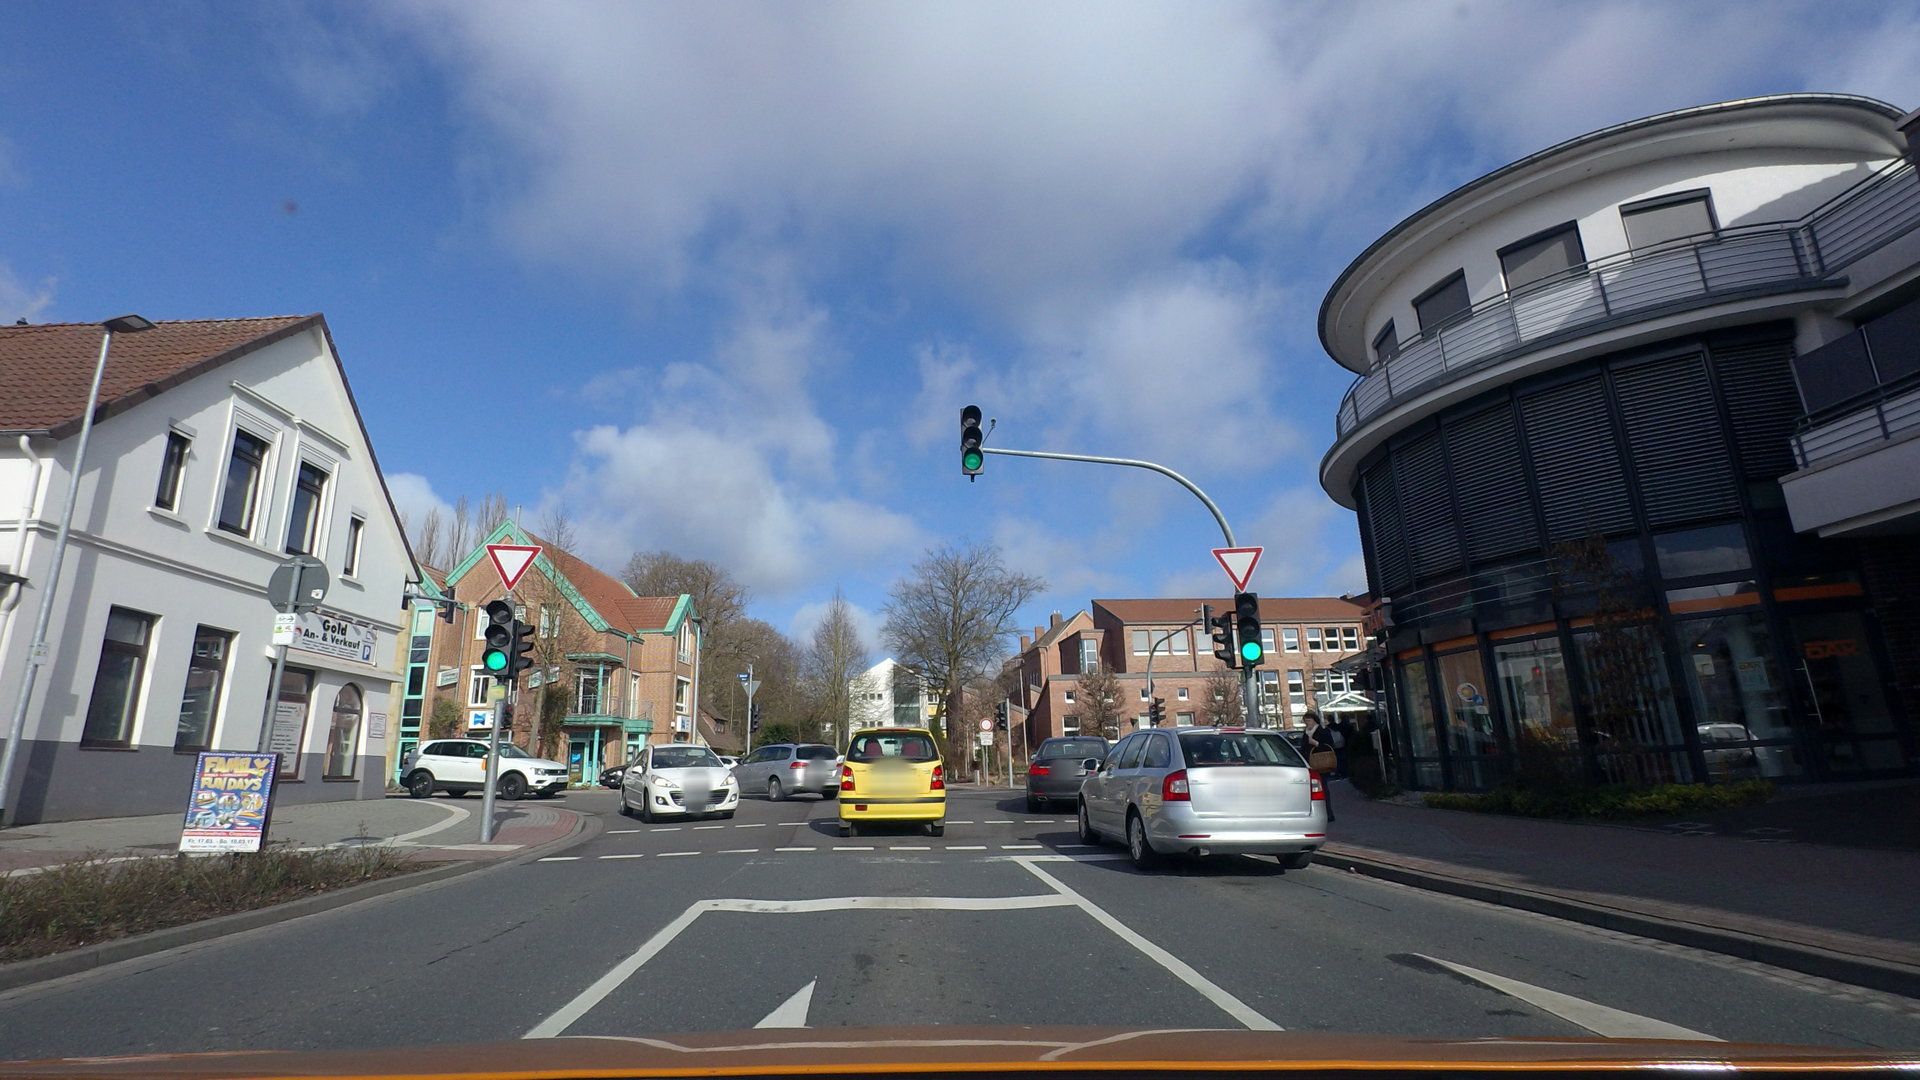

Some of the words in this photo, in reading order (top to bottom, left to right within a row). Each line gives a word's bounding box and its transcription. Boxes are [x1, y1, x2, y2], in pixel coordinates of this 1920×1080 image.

[323, 619, 348, 636] Gold
[303, 628, 319, 639] An-
[321, 633, 328, 642] &
[331, 634, 361, 650] Verkauf
[362, 645, 371, 660] P
[204, 757, 270, 774] FAMILY
[201, 777, 226, 790] FUN
[227, 777, 262, 791] DAYS
